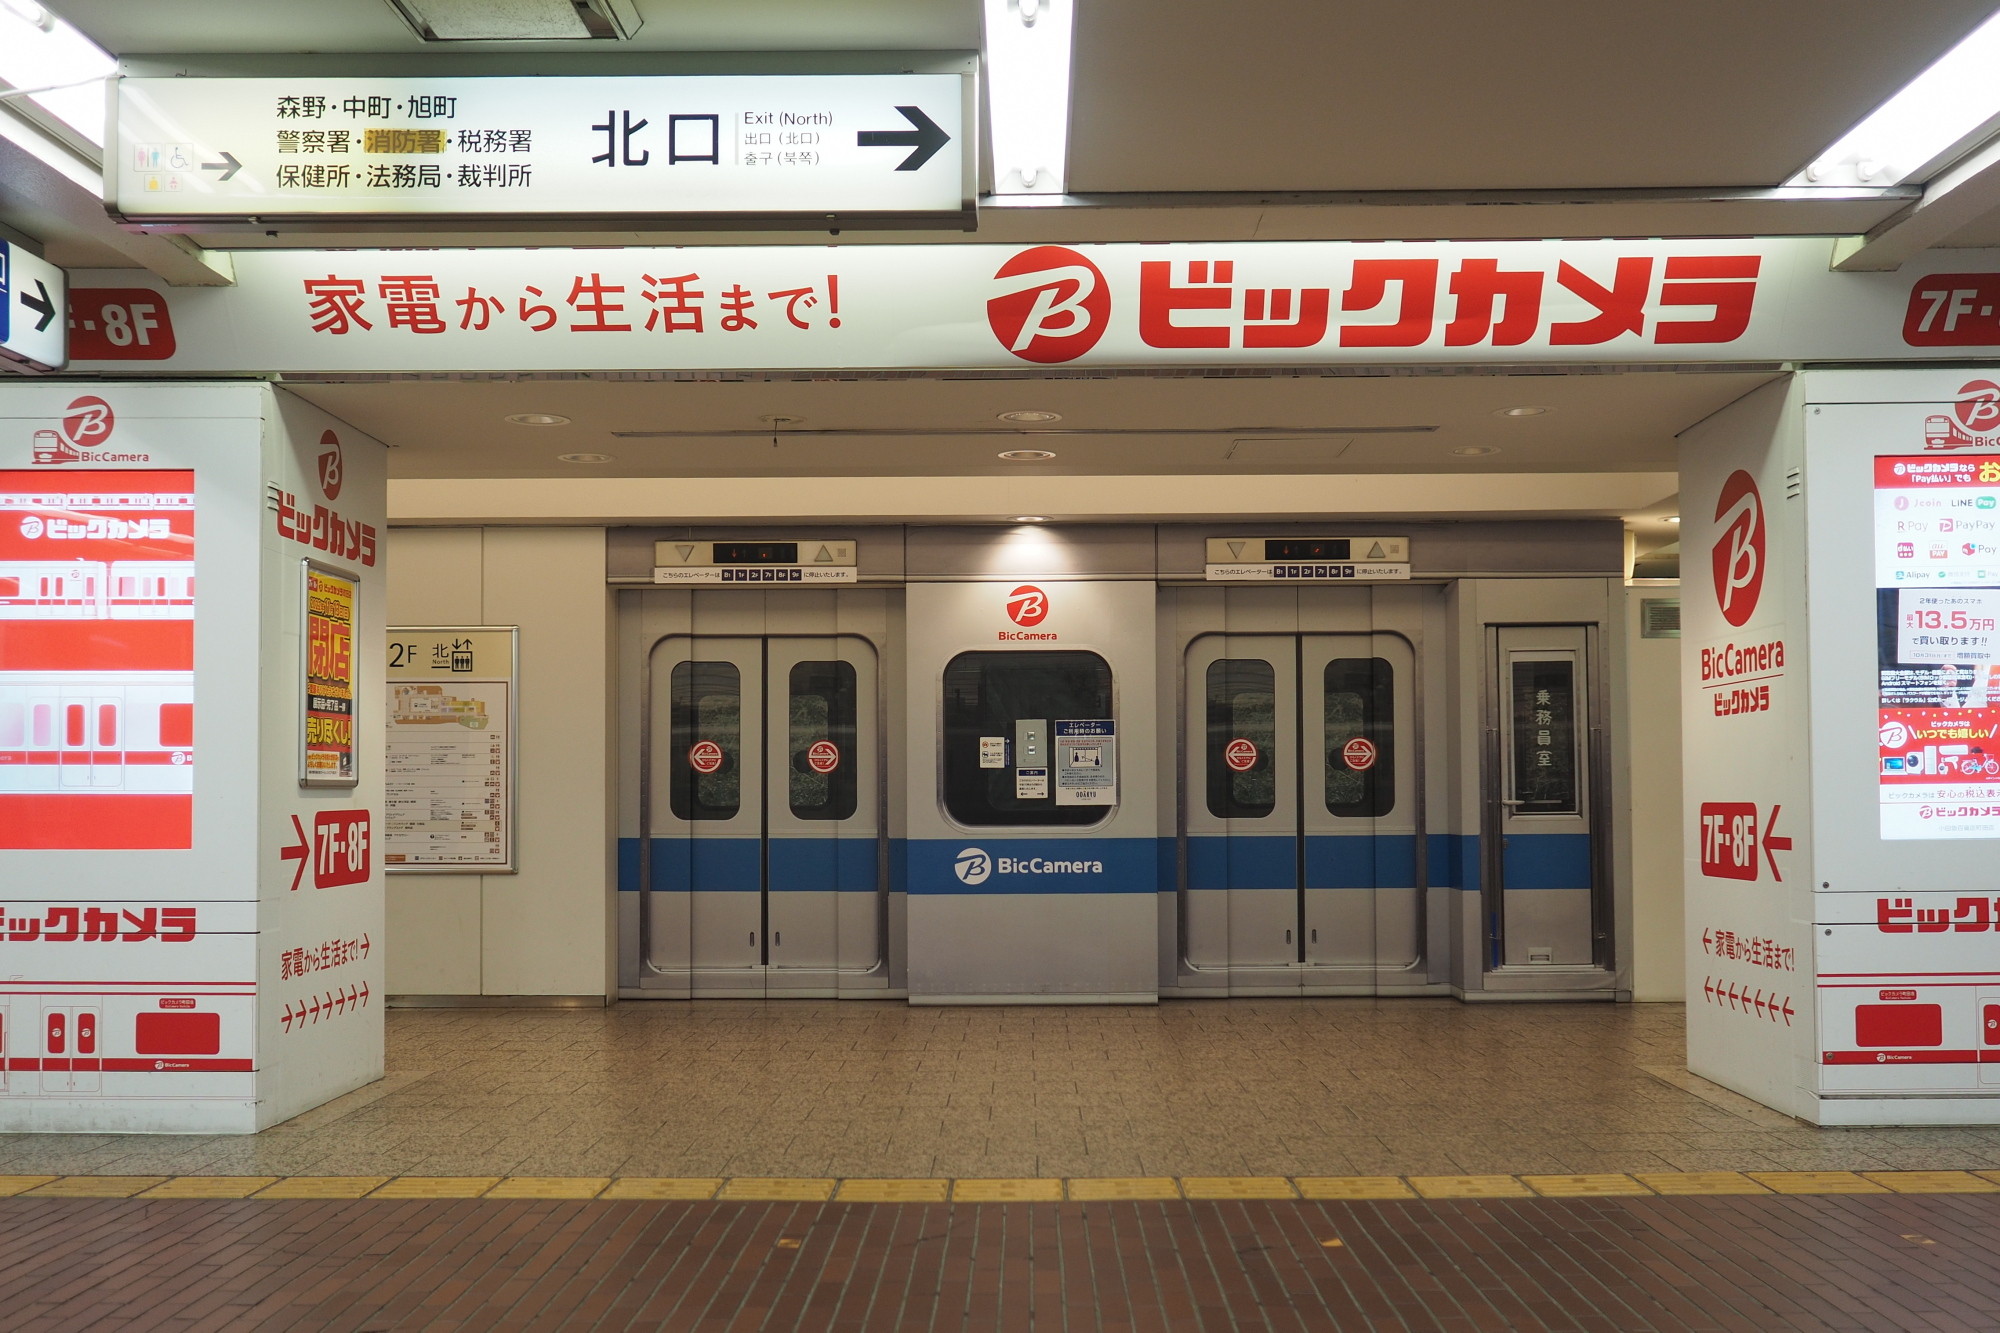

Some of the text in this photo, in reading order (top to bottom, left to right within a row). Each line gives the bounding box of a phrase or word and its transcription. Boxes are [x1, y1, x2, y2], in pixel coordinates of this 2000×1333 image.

[276, 95, 457, 119] 森野・中町・旭町
[744, 111, 833, 127] Exit (North)
[276, 129, 532, 154] 警察署・消防署・税務署
[591, 110, 719, 167] 北口
[744, 152, 820, 165] 출구 (북쪽)
[276, 163, 532, 188] 保健所・法務局・裁判所
[303, 272, 842, 335] 家電から生活まで!
[1138, 254, 1762, 349] ビックカメラ
[1917, 289, 2000, 332] 7F・
[81, 452, 149, 462] BicCamera
[1907, 463, 1975, 473] ビックカメラなら
[1951, 498, 1994, 508] LINE Pay
[47, 518, 170, 539] ビックカメラ
[277, 489, 376, 567] ビックカメラ
[1908, 521, 1928, 532] Pay
[1956, 520, 1996, 531] PayPay
[1978, 544, 1997, 555] Pay
[662, 571, 720, 579] こちらのエレベーターは
[1214, 568, 1272, 576] こちらのエレベーターは
[1906, 571, 1930, 579] Alipay
[998, 630, 1057, 641] BicCamera
[389, 642, 417, 668] 2F
[432, 643, 449, 658] 北
[1701, 640, 1784, 681] BicCamera
[1714, 685, 1769, 717] ビックカメラ
[1536, 689, 1553, 767] 乗務員室
[1917, 728, 1989, 739] いつでも嬉しい
[1936, 806, 2000, 817] ビックカメラ
[997, 857, 1103, 875] BicCamera
[0, 906, 196, 942] ックカメラ
[1877, 897, 2000, 933] ビック
[281, 938, 358, 981] 家電から生活まで!
[1715, 930, 1795, 972] 家電から生活まで!
